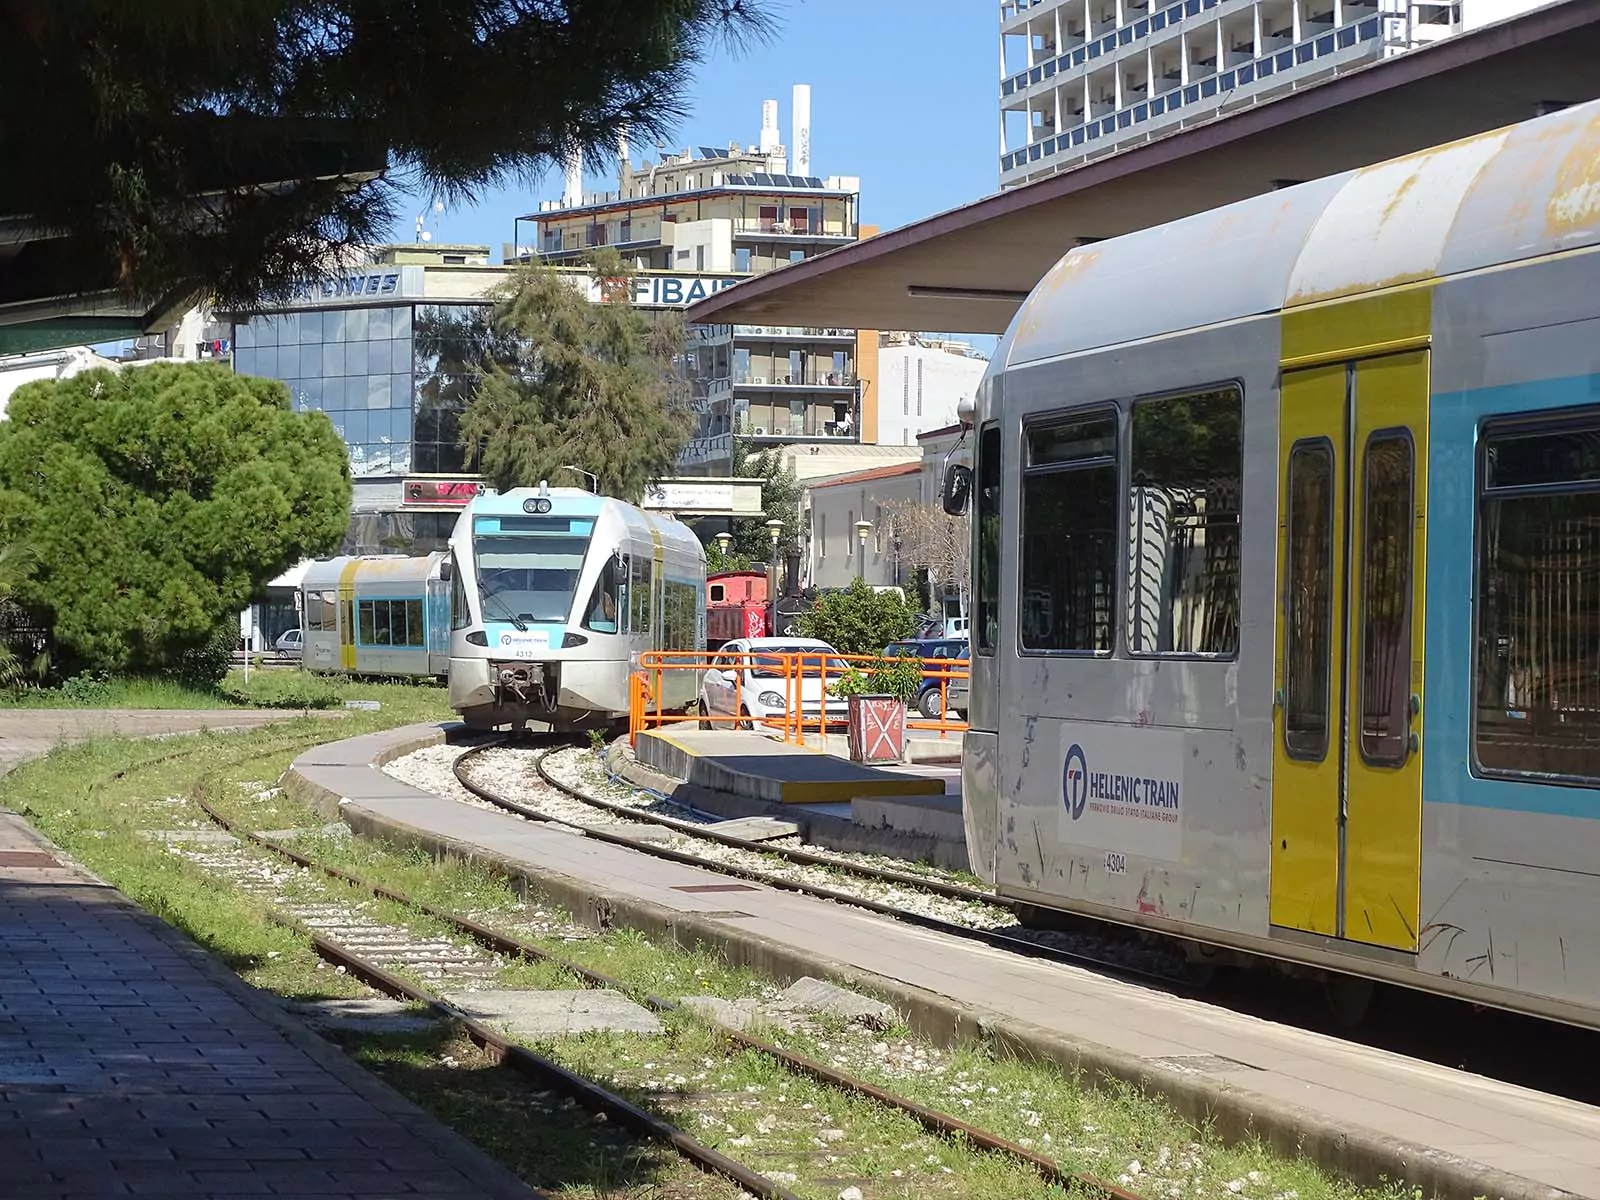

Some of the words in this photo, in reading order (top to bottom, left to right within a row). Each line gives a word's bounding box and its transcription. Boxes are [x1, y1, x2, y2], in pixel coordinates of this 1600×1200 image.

[1090, 772, 1142, 804] HELLENIC
[1143, 778, 1179, 809] TRAIN
[1125, 807, 1139, 818] STATO
[1106, 853, 1125, 873] 4304
